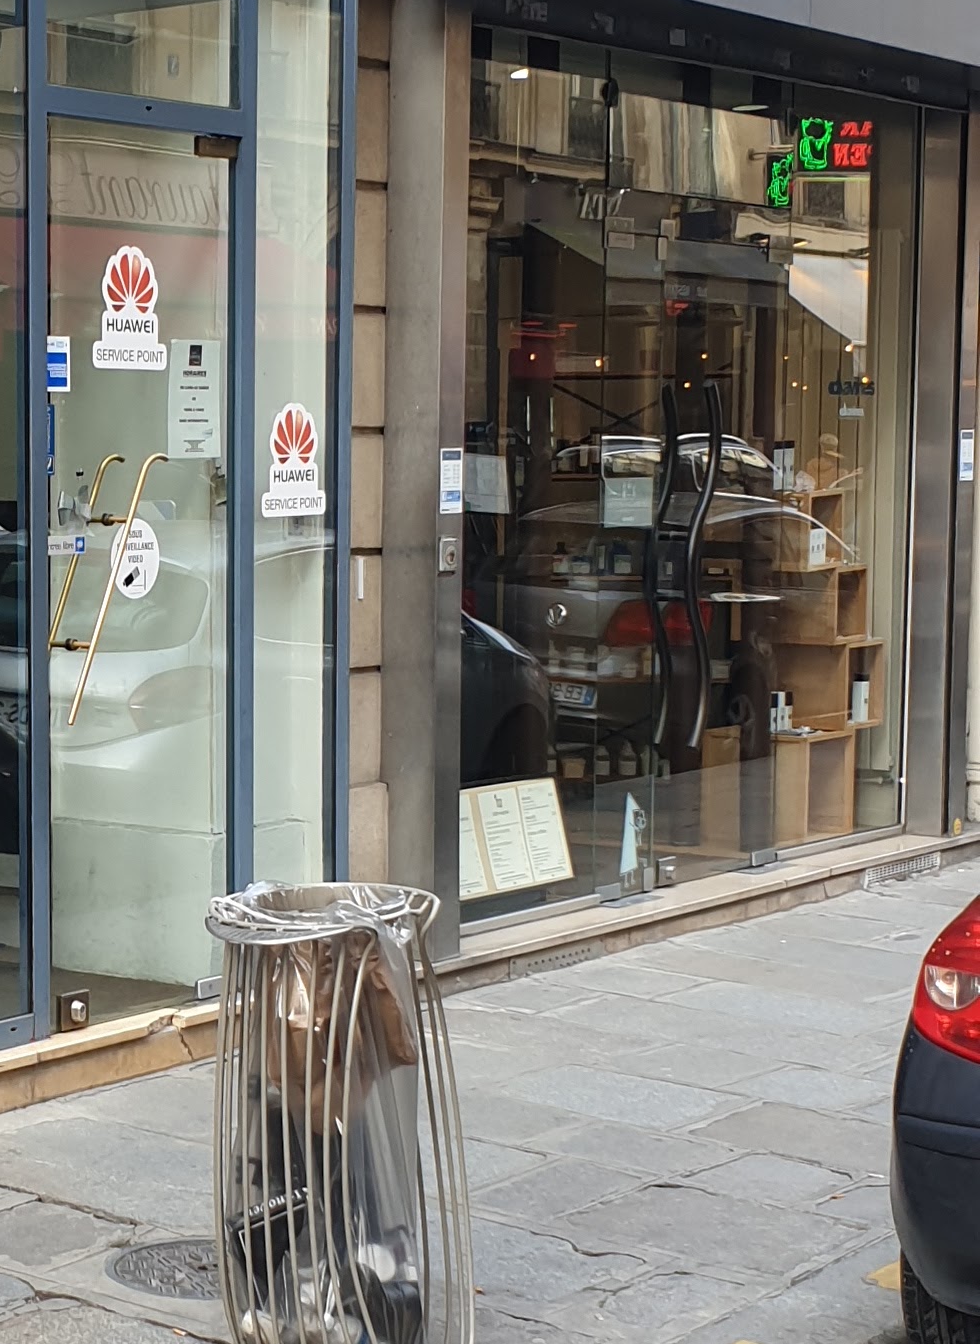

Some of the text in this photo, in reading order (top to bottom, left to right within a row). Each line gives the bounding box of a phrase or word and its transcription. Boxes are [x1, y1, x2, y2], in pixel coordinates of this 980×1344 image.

[106, 318, 155, 334] HUAWEI
[95, 346, 164, 364] SERVICE POINT
[273, 468, 315, 483] HUAWEI
[264, 495, 323, 511] SERVICE POINT
